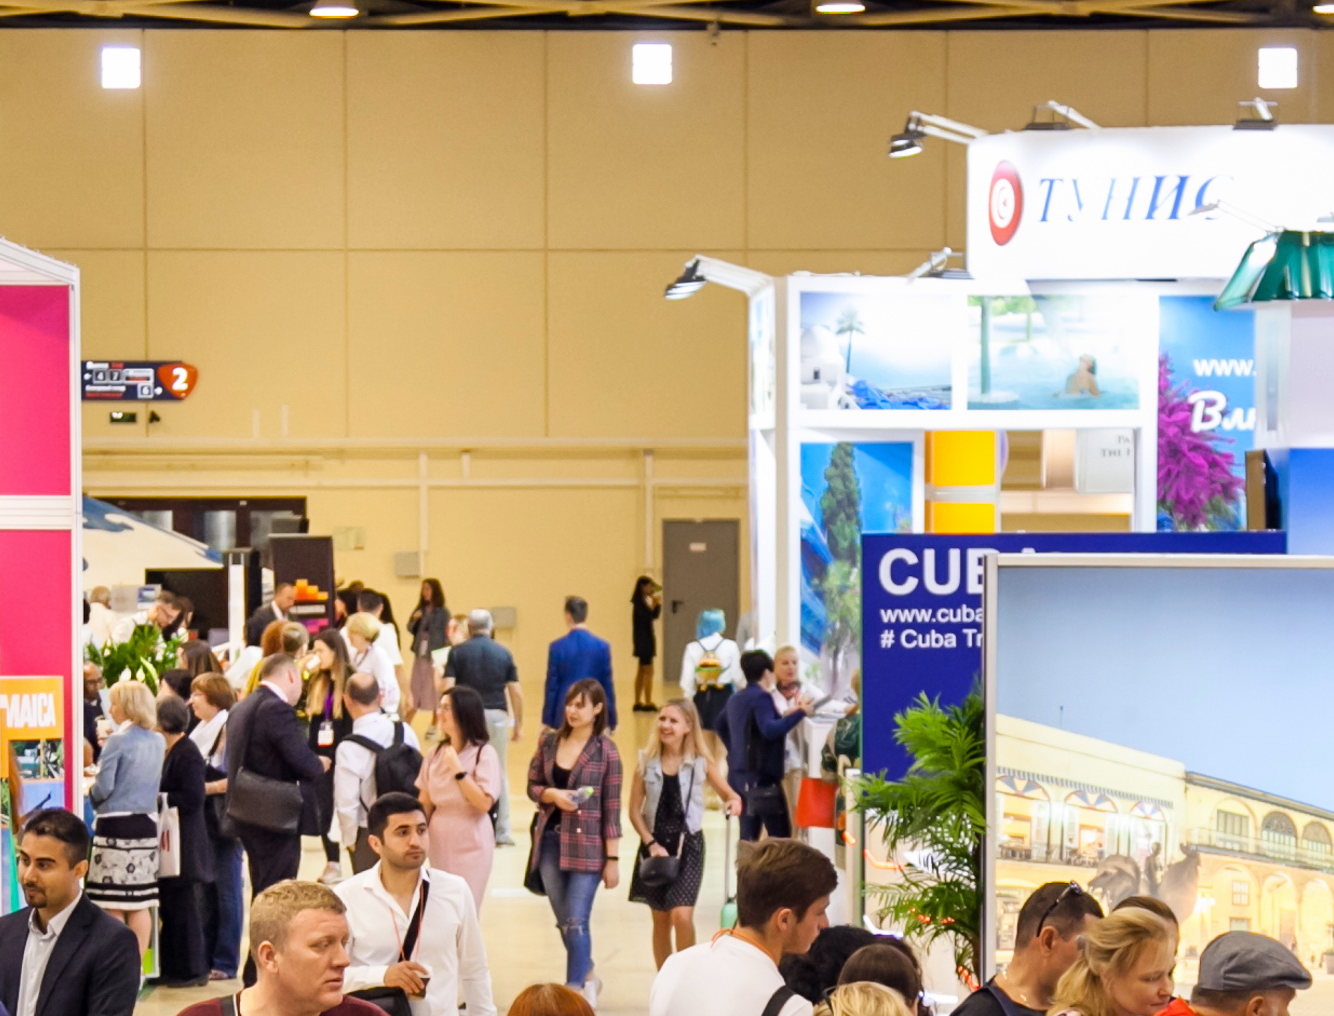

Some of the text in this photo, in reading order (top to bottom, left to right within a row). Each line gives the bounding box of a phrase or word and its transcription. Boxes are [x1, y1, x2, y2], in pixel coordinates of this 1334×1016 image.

[171, 366, 189, 391] 2
[879, 547, 1036, 596] CUB
[900, 628, 957, 649] Cuba
